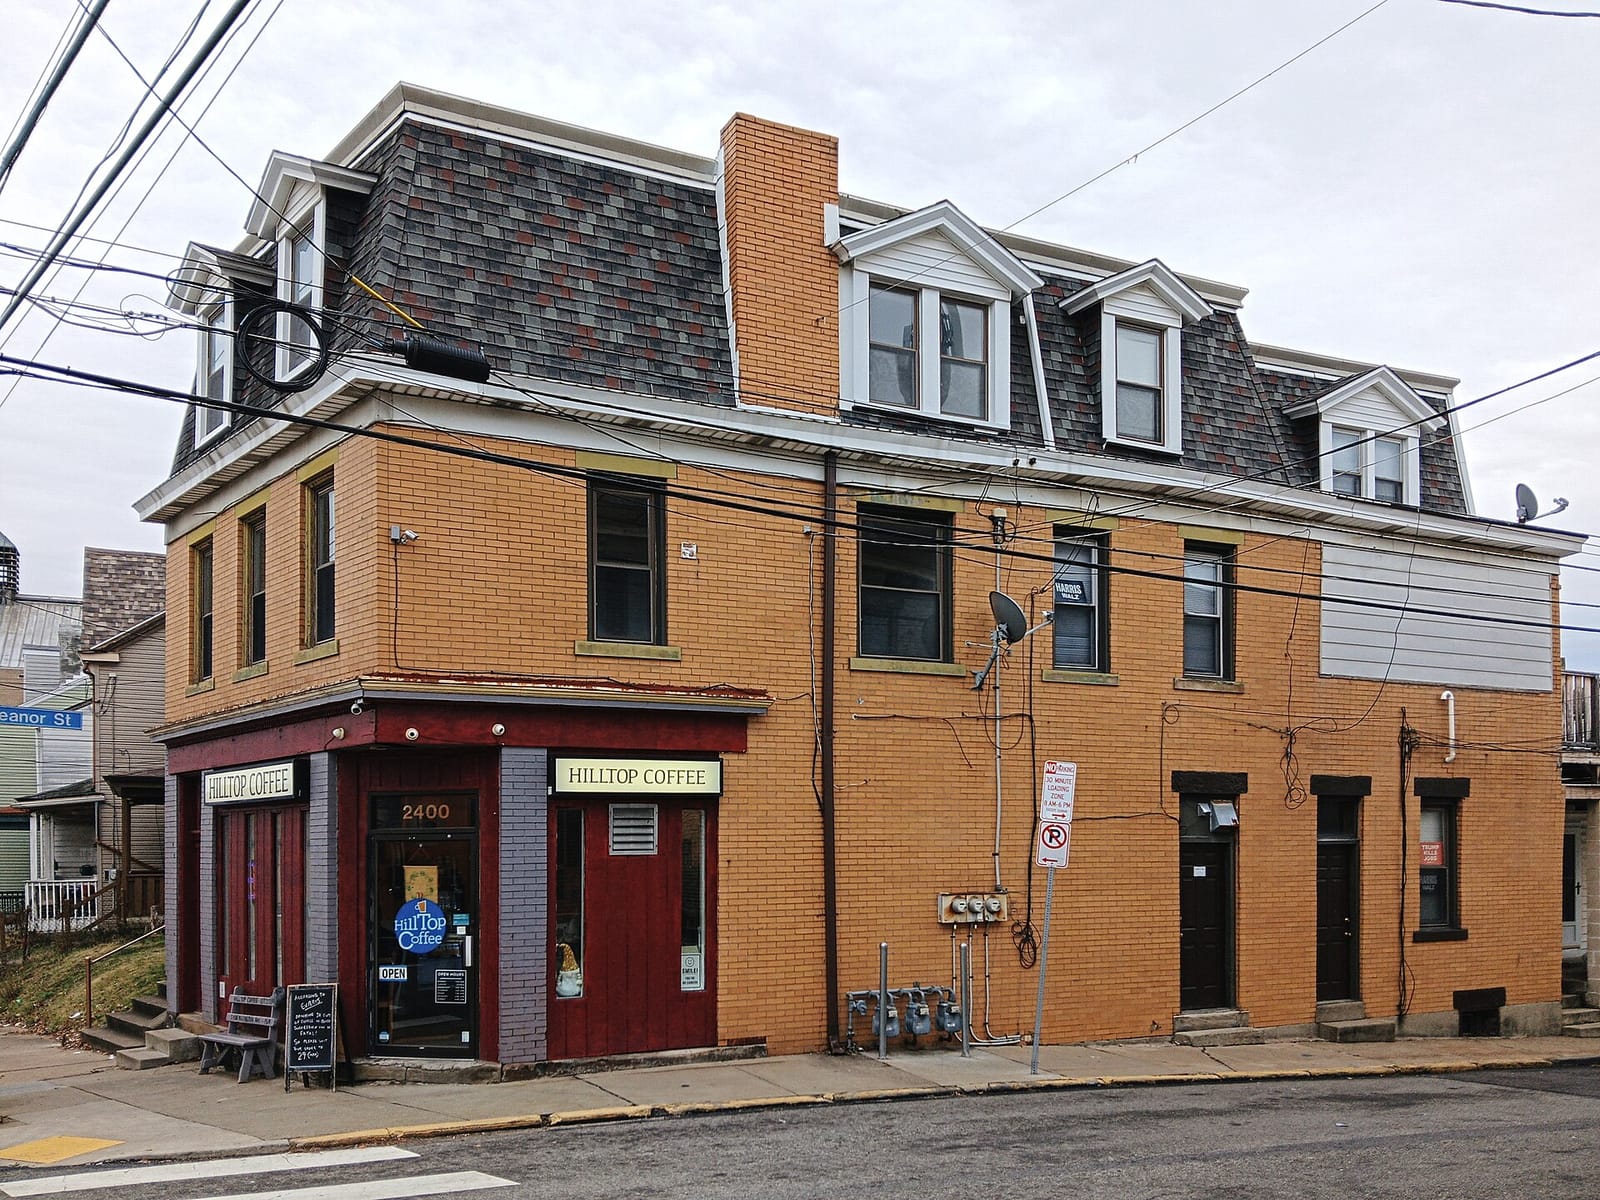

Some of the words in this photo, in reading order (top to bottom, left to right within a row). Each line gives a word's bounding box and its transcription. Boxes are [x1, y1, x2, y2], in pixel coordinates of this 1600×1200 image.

[1055, 582, 1082, 594] HARRIS
[54, 713, 71, 726] St
[1046, 762, 1057, 774] NO
[208, 774, 247, 799] HILLTOP
[249, 768, 289, 796] COFFEE
[569, 768, 638, 784] HILLTOP
[643, 769, 706, 785] COFFEE
[402, 804, 450, 820] 2400
[398, 931, 442, 950] Coffee
[382, 968, 405, 979] OPEN
